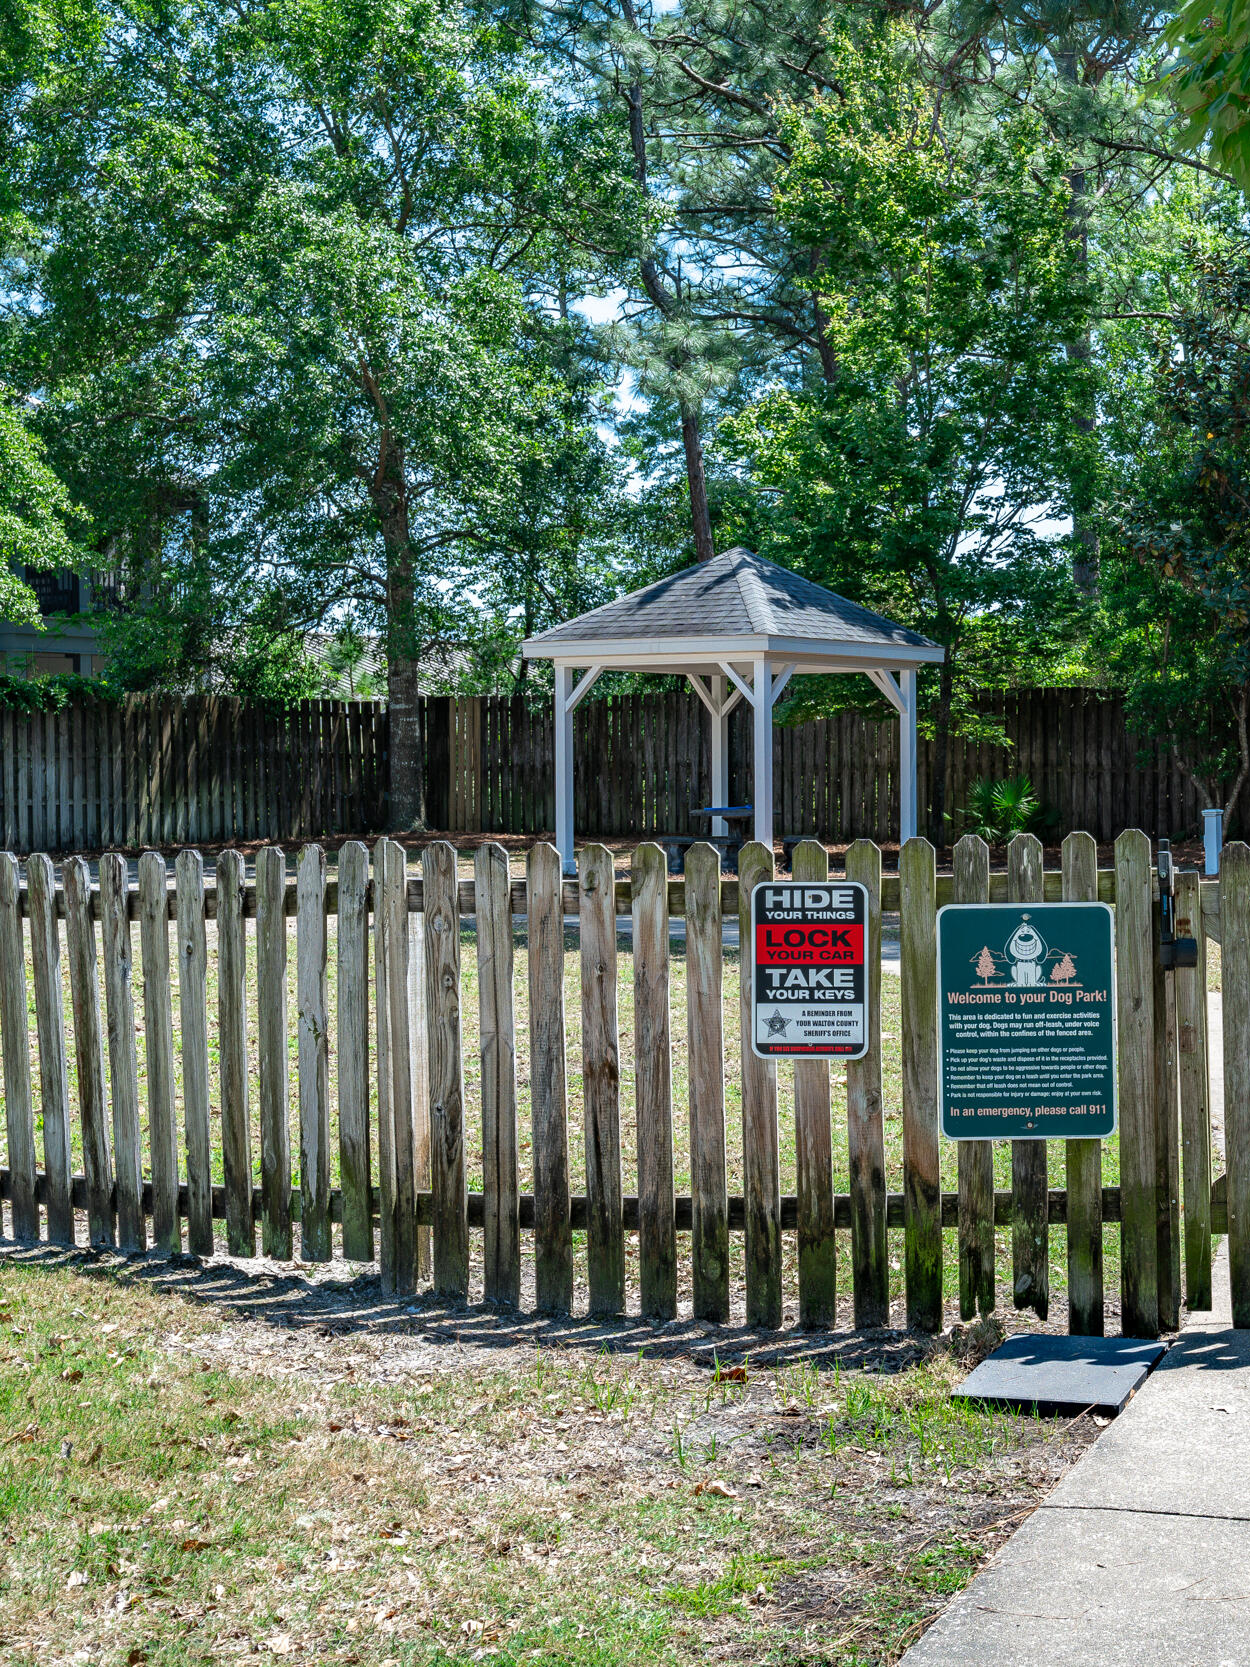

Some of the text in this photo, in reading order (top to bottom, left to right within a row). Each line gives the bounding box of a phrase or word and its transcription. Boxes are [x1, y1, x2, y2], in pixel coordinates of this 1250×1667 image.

[766, 890, 854, 908] HIDE
[766, 930, 851, 947] LOCK
[767, 951, 854, 960] YOUR CAR
[766, 969, 854, 987] TAKE
[766, 990, 855, 999] YOUR KEYS
[948, 990, 1107, 1005] Welcome to your Dog Park!
[950, 1105, 1106, 1118] In an emergency, please call 911
